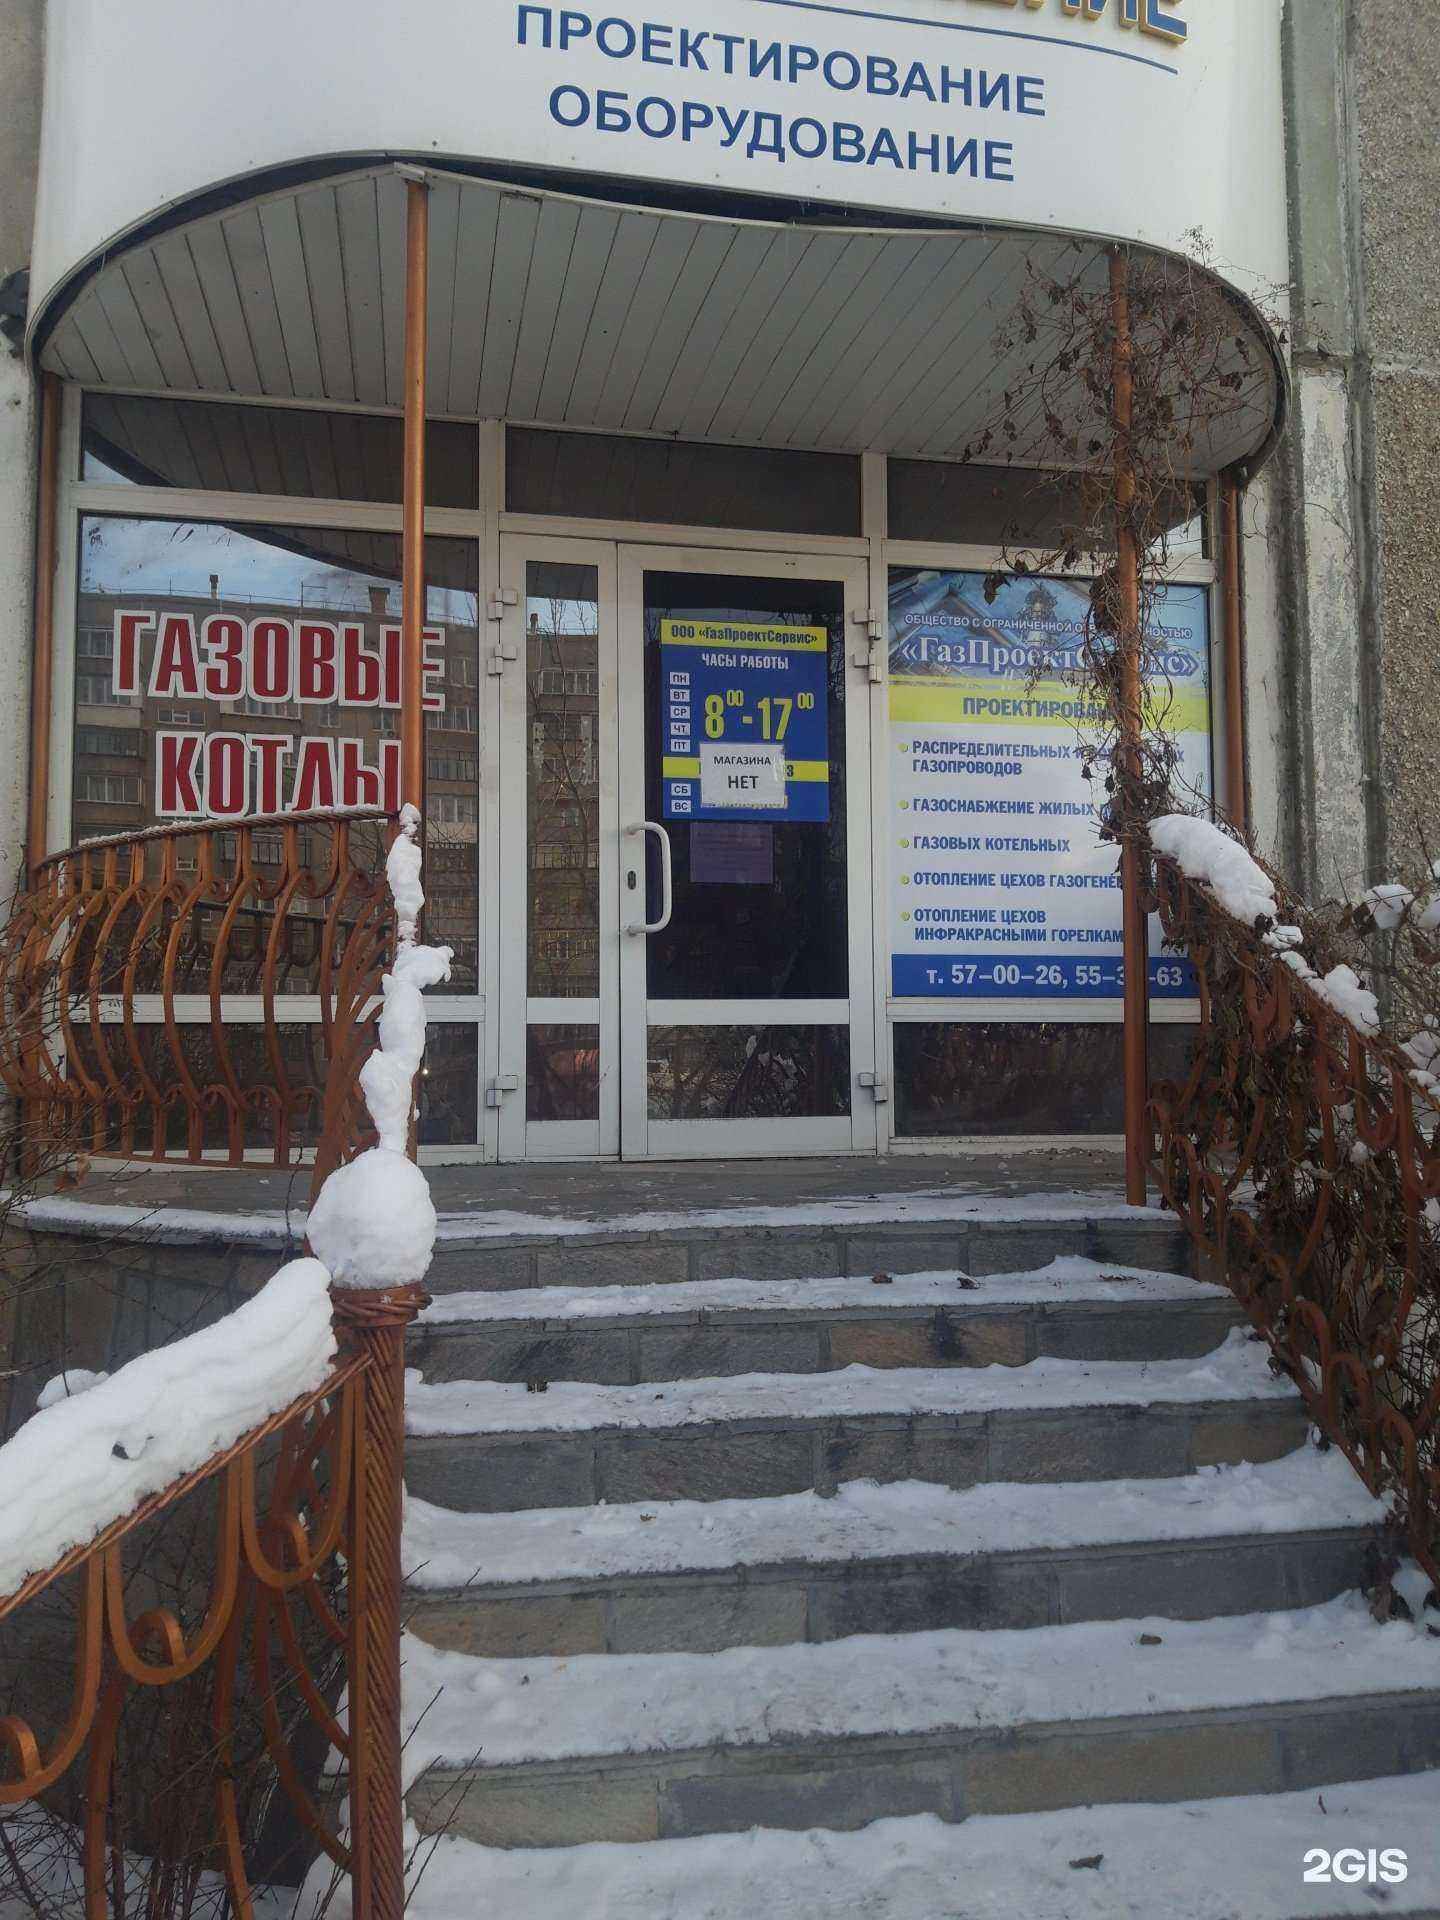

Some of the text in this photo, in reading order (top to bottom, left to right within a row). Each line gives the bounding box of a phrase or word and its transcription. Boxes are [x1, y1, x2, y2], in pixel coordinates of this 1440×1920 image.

[516, 4, 1047, 117] ПРОЕКТИРОВАНИЕ
[548, 84, 1016, 182] ОБОРУДОВАНИЕ
[904, 614, 970, 627] ОБЩЕСТВО
[972, 617, 980, 628] С
[983, 618, 1072, 632] ОГРАНИЧЕННОЙ
[671, 625, 817, 644] ООО «ГазПроектСервис»
[112, 609, 446, 712] ГАЗОВЫЕ
[702, 653, 789, 670] ЧАСЫ РАБОТЫ
[672, 674, 687, 684] ПН
[673, 690, 687, 700] ВТ
[673, 707, 687, 717] СР
[673, 724, 687, 734] ЧТ
[673, 740, 687, 750] ПТ
[912, 740, 1071, 759] РАСПРЕДЕЛИТЕЛЬНЫХ
[713, 755, 772, 766] МАГАЗИНА
[912, 760, 1023, 778] ГАЗОПРОВОДОВ
[155, 731, 402, 818] КОТЛЫ
[727, 775, 760, 790] НЕТ
[674, 785, 689, 795] СБ
[674, 802, 689, 812] ВС
[912, 798, 1035, 815] ГАЗОСНАБЖЕНИЕ
[1038, 800, 1094, 816] ЖИЛЫХ
[913, 836, 1071, 853] ГАЗОВЫХ КОТЕЛЬНЫХ
[913, 872, 997, 886] ОТОПЛЕНИЕ
[1000, 873, 1046, 889] ЦЕХОВ
[914, 909, 1047, 926] ОТОПЛЕНИЕ ЦЕХОВ
[914, 926, 1124, 943] ИНФРАКРАСНЫМИ ГОРЕЛКАМ
[926, 967, 944, 984] т.
[1075, 965, 1183, 986] 55-3-63
